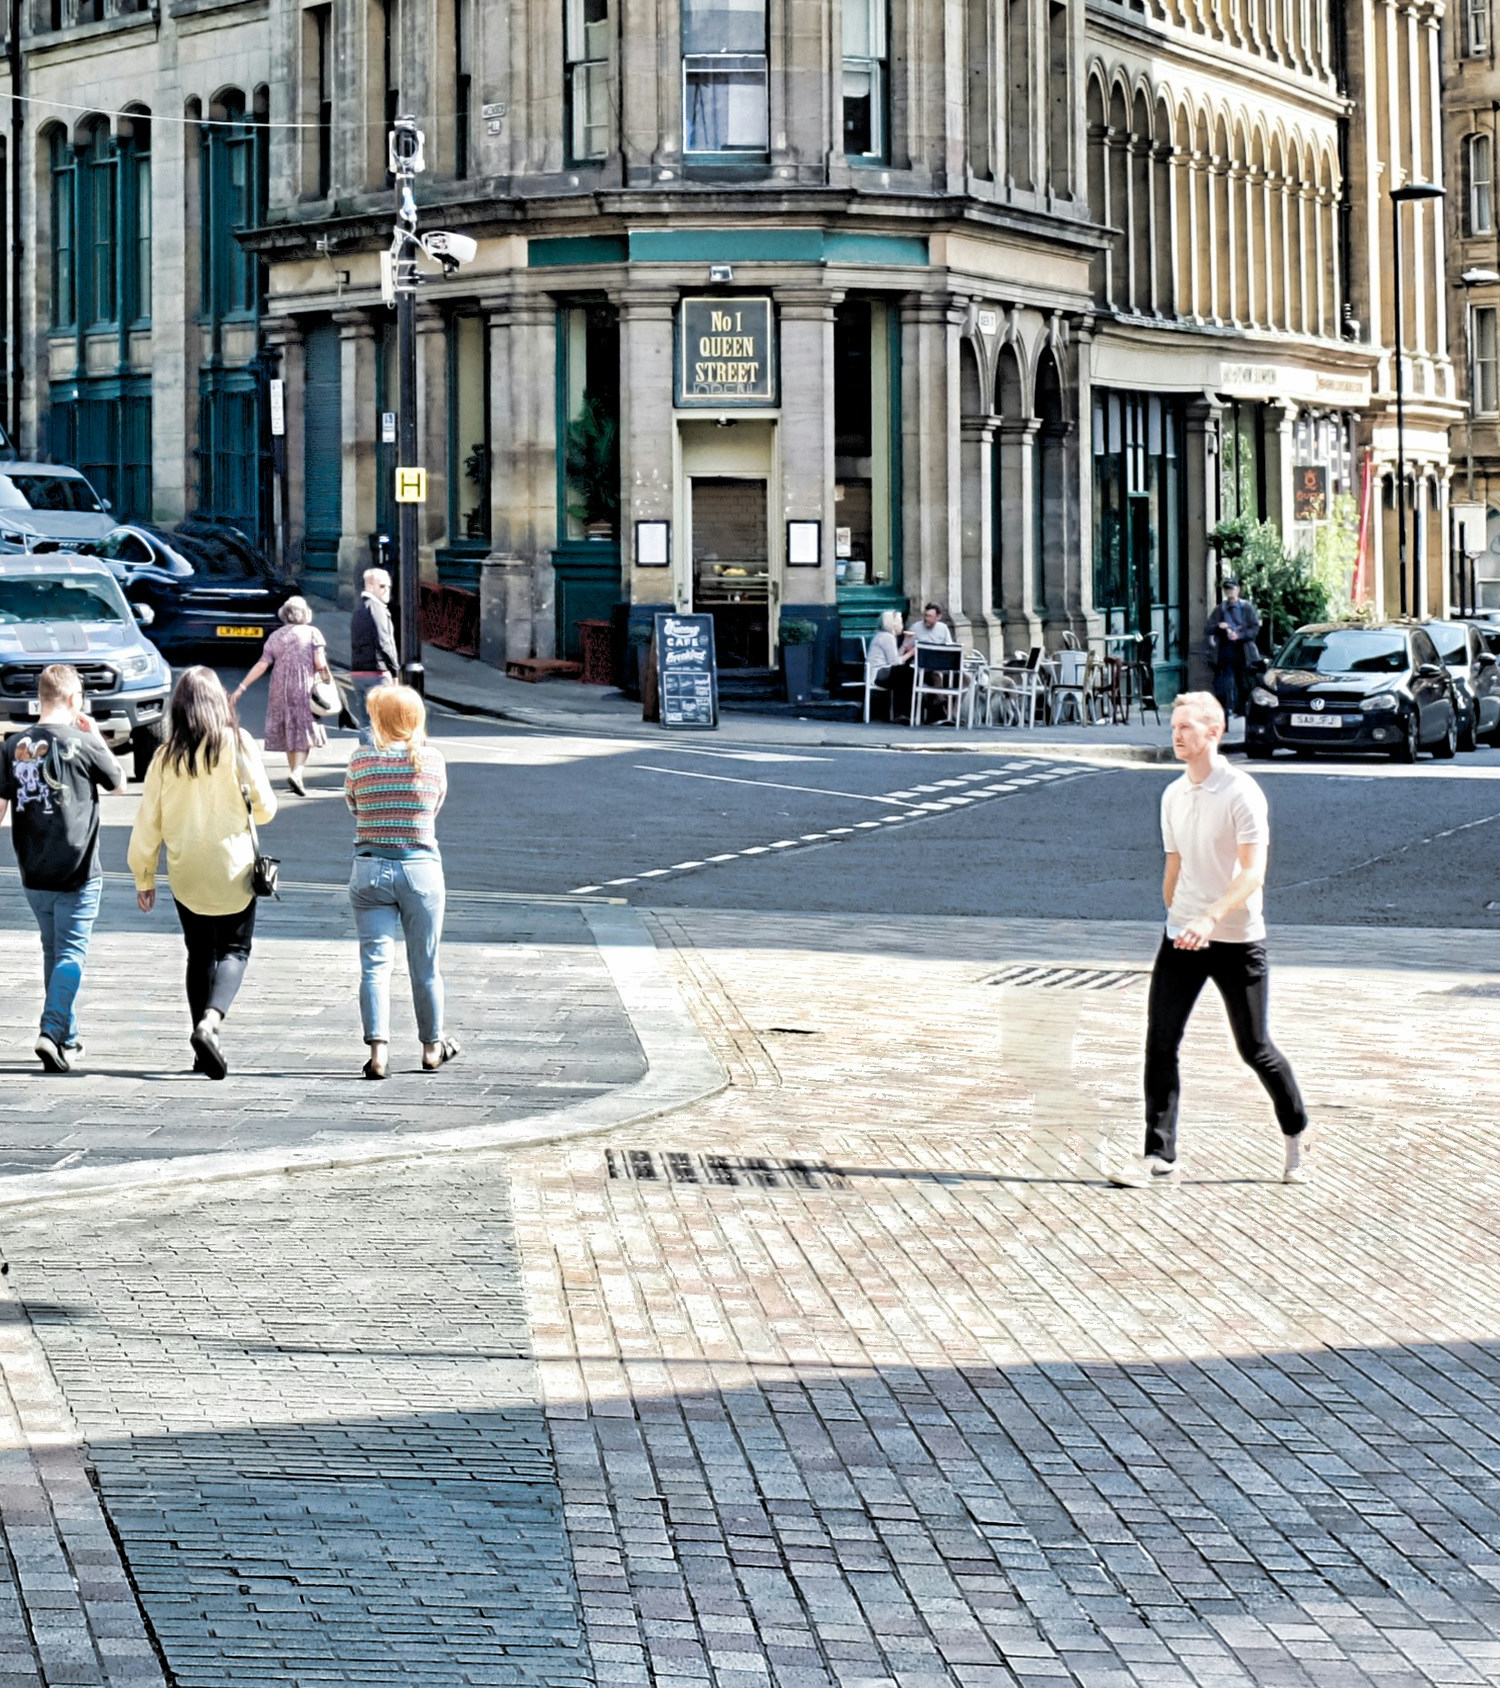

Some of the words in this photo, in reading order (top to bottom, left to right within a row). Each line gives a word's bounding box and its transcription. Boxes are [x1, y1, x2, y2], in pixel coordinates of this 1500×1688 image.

[711, 310, 732, 332] No
[735, 311, 743, 332] 1
[699, 336, 755, 357] QUEEN
[695, 361, 760, 383] STREET
[401, 471, 421, 498] H
